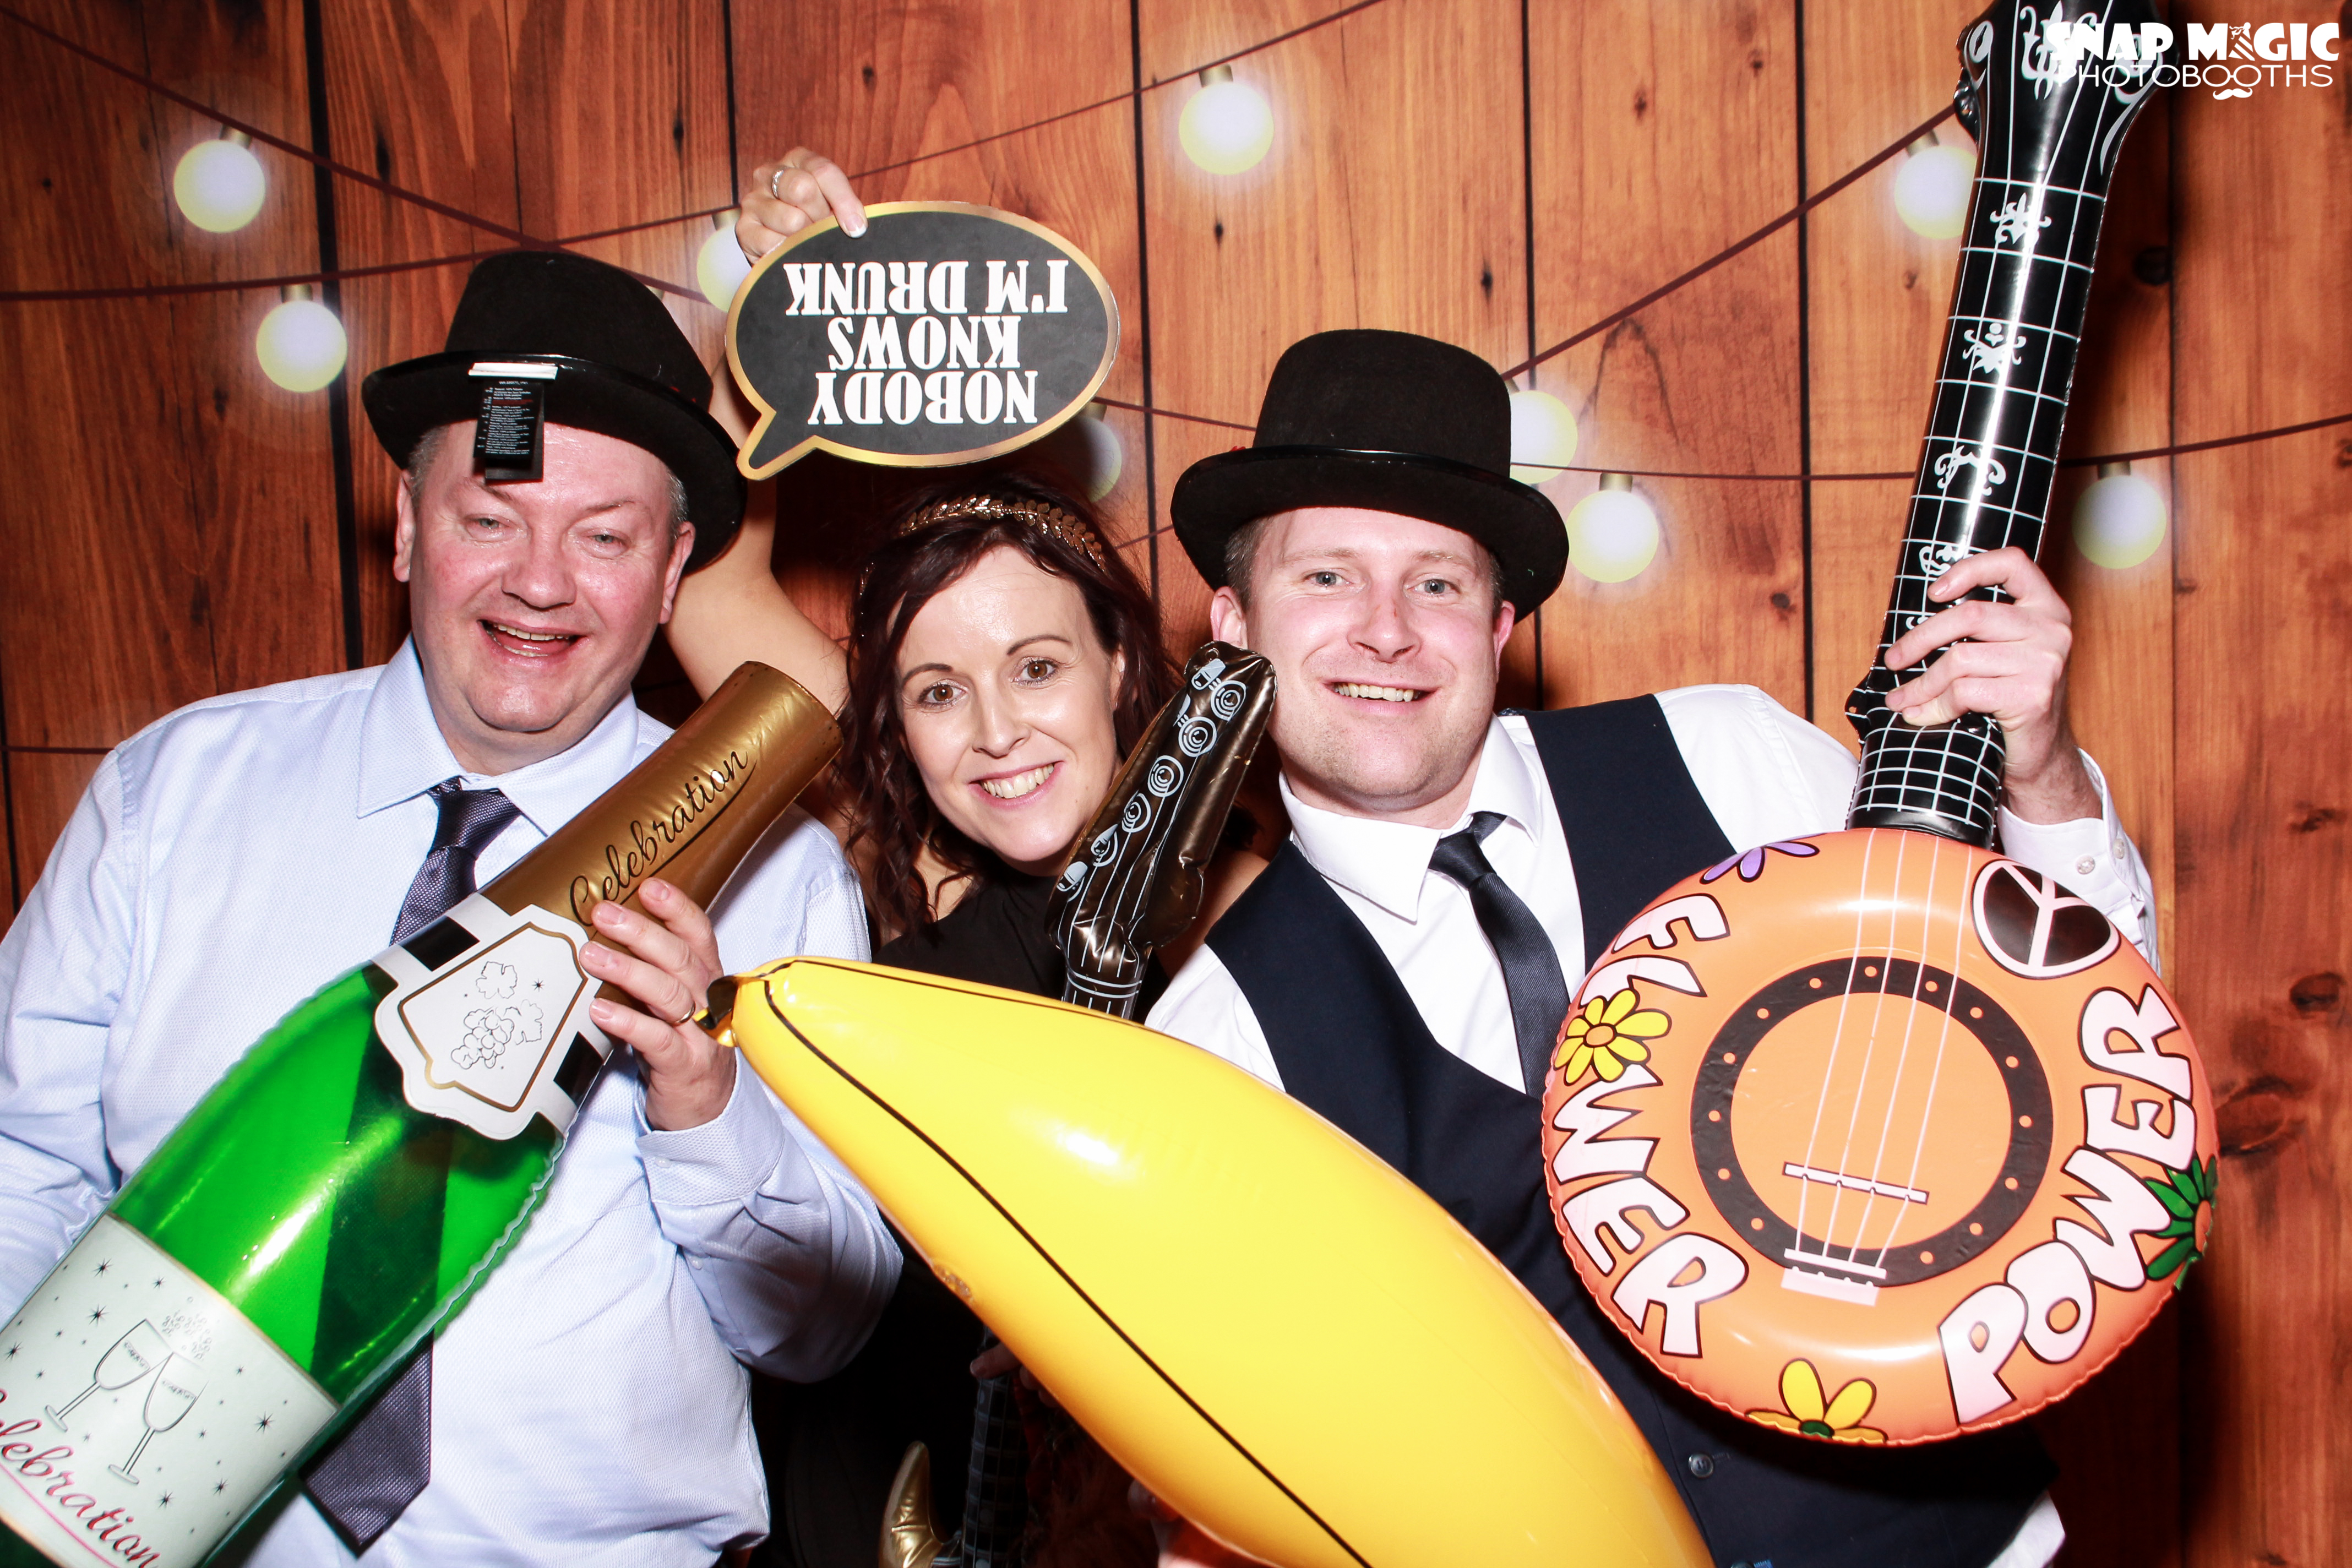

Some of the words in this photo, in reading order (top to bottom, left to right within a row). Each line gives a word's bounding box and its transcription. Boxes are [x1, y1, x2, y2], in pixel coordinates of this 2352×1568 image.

[783, 261, 969, 316] DRUNK
[985, 260, 1069, 314] I'M
[827, 315, 1021, 371] KNOWS
[807, 371, 1039, 426] NOBODY
[569, 750, 748, 927] Celebration
[1937, 982, 2196, 1425] POWER
[0, 1388, 161, 1568] lebration
